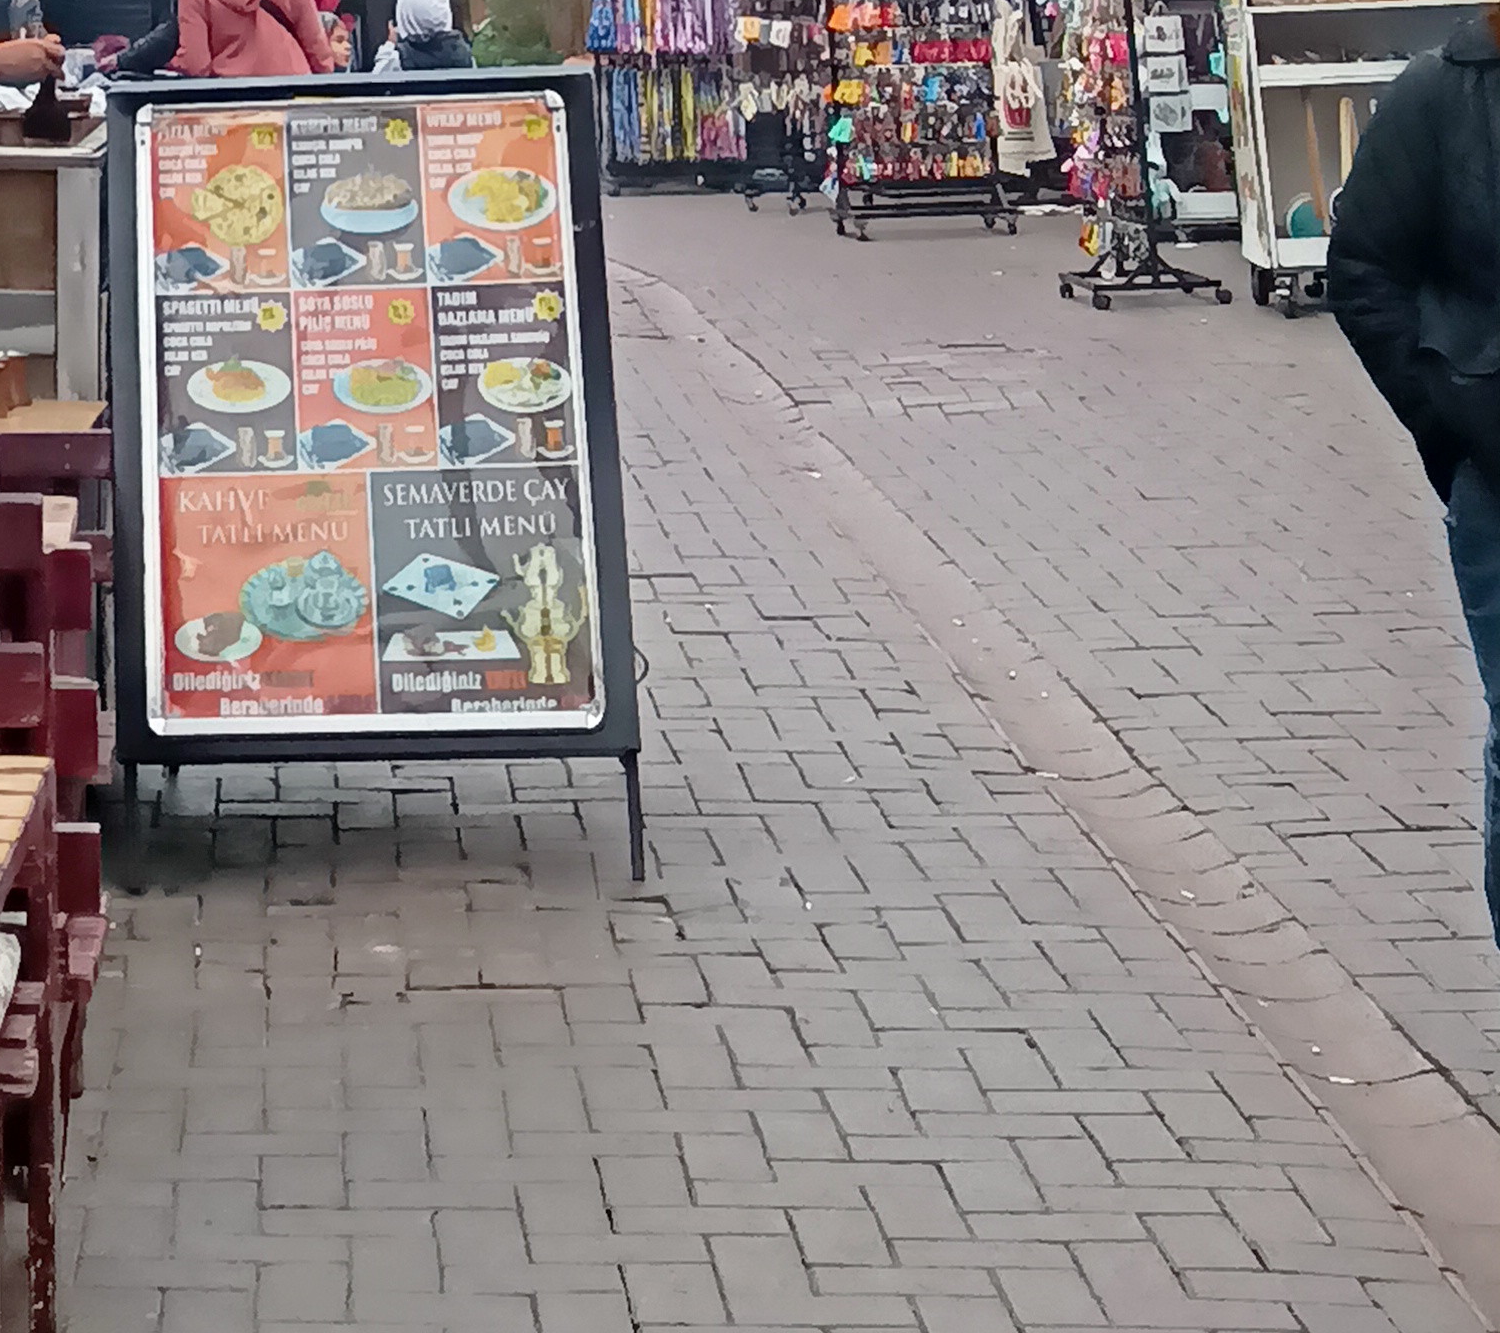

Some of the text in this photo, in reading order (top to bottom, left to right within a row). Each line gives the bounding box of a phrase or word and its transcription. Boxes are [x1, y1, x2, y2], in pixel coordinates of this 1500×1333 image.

[383, 477, 570, 507] SEMAVERDE ÇAY
[403, 510, 557, 540] TATLI MENÜ
